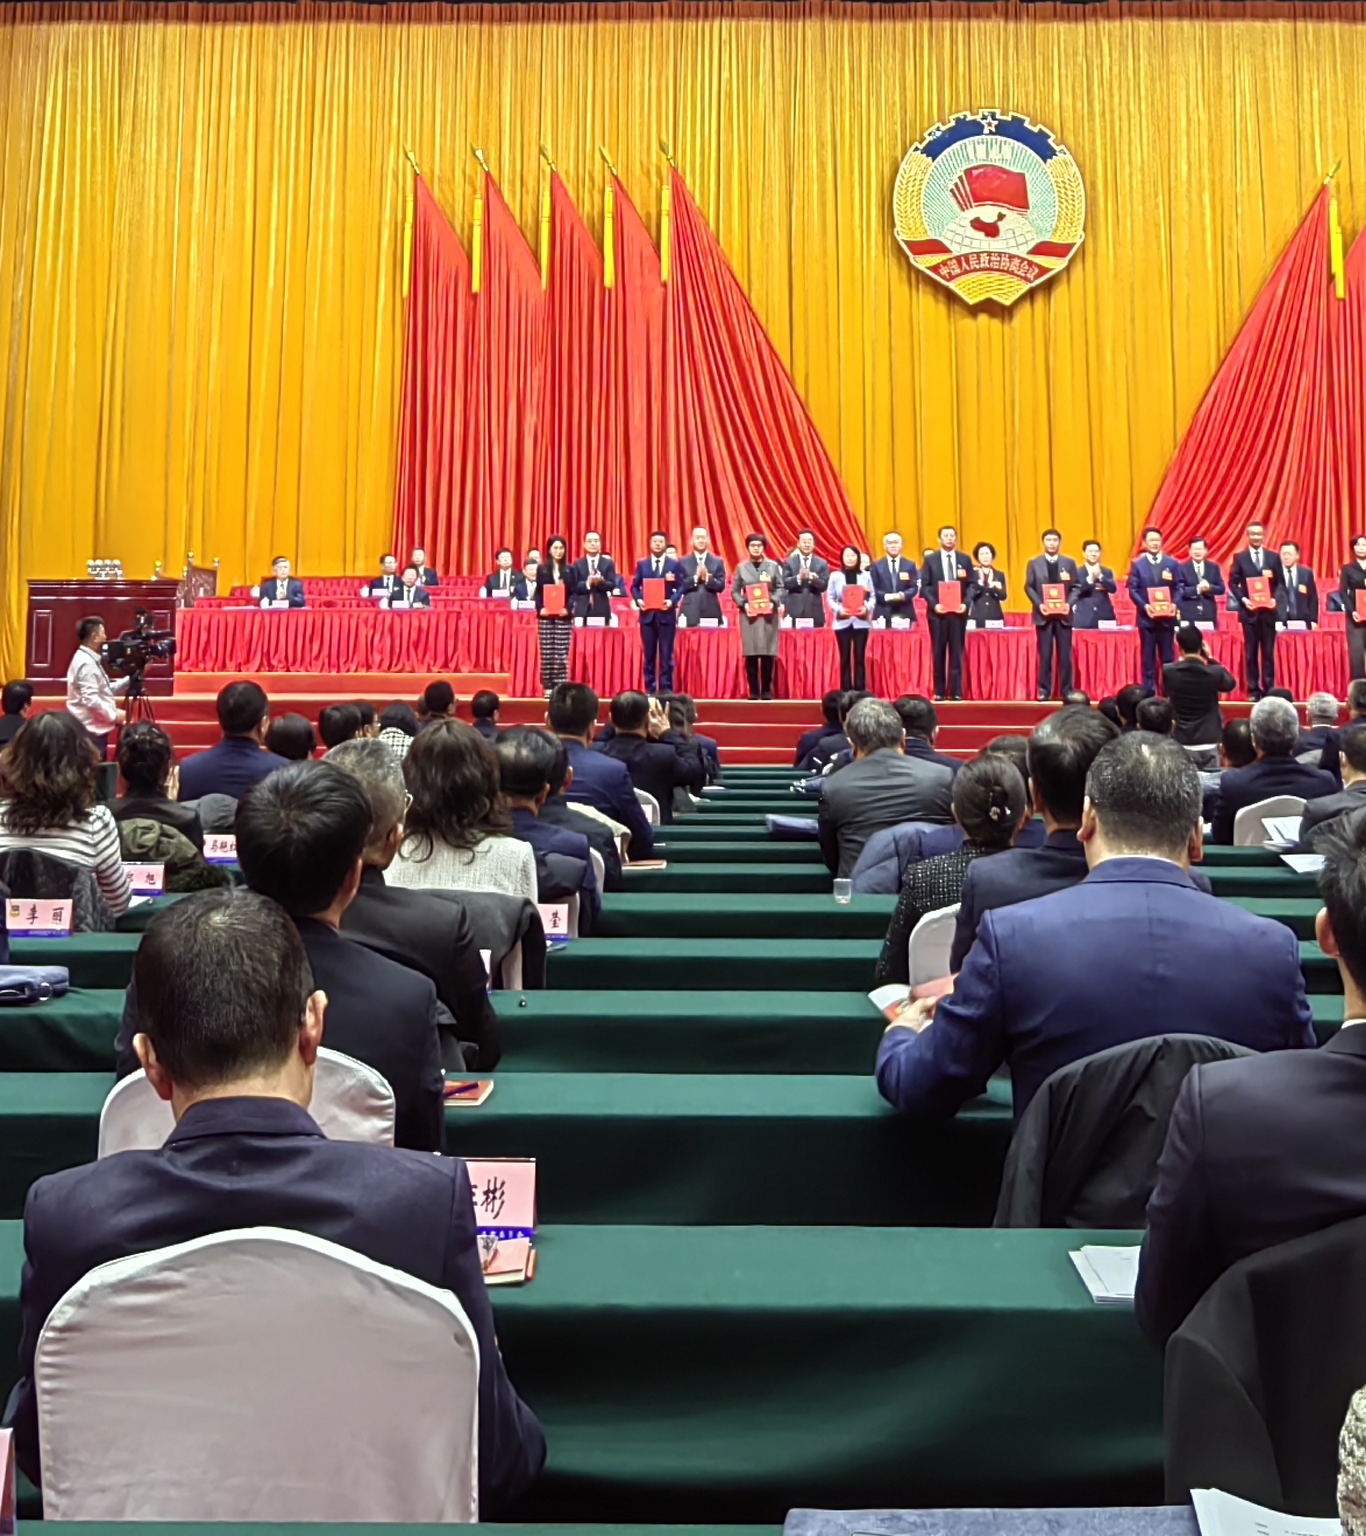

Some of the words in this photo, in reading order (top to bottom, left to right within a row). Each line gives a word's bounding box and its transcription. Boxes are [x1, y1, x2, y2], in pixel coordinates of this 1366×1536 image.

[938, 252, 1039, 281] 中国人民政治协商会议
